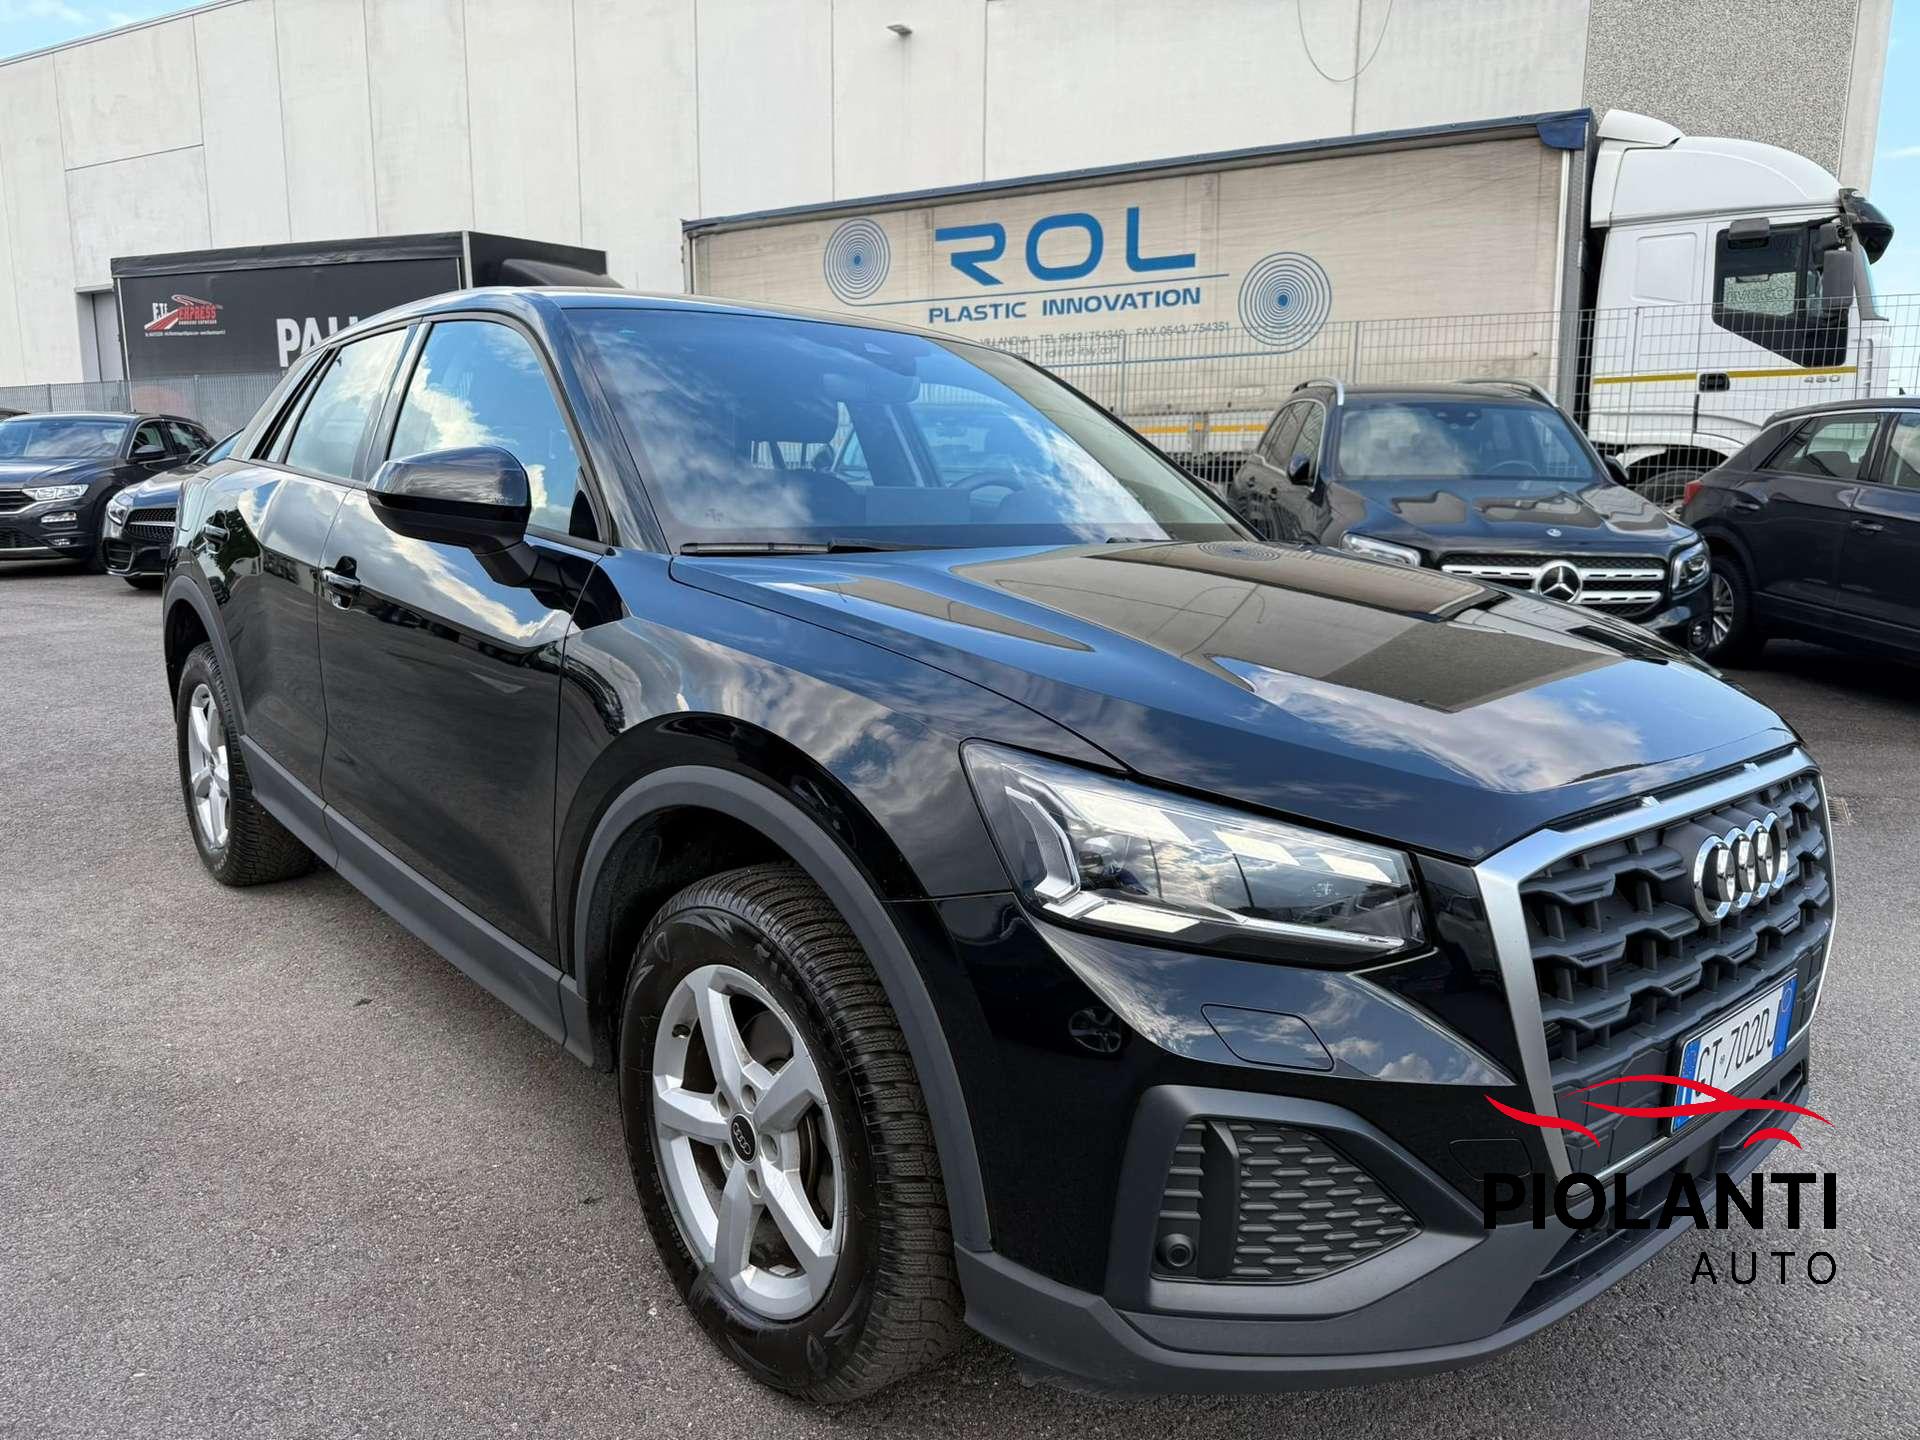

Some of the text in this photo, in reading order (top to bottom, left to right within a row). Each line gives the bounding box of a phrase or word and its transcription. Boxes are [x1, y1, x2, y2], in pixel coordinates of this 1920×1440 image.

[935, 207, 1196, 287] ROL
[929, 287, 1201, 324] PLASTIC INNOVATION
